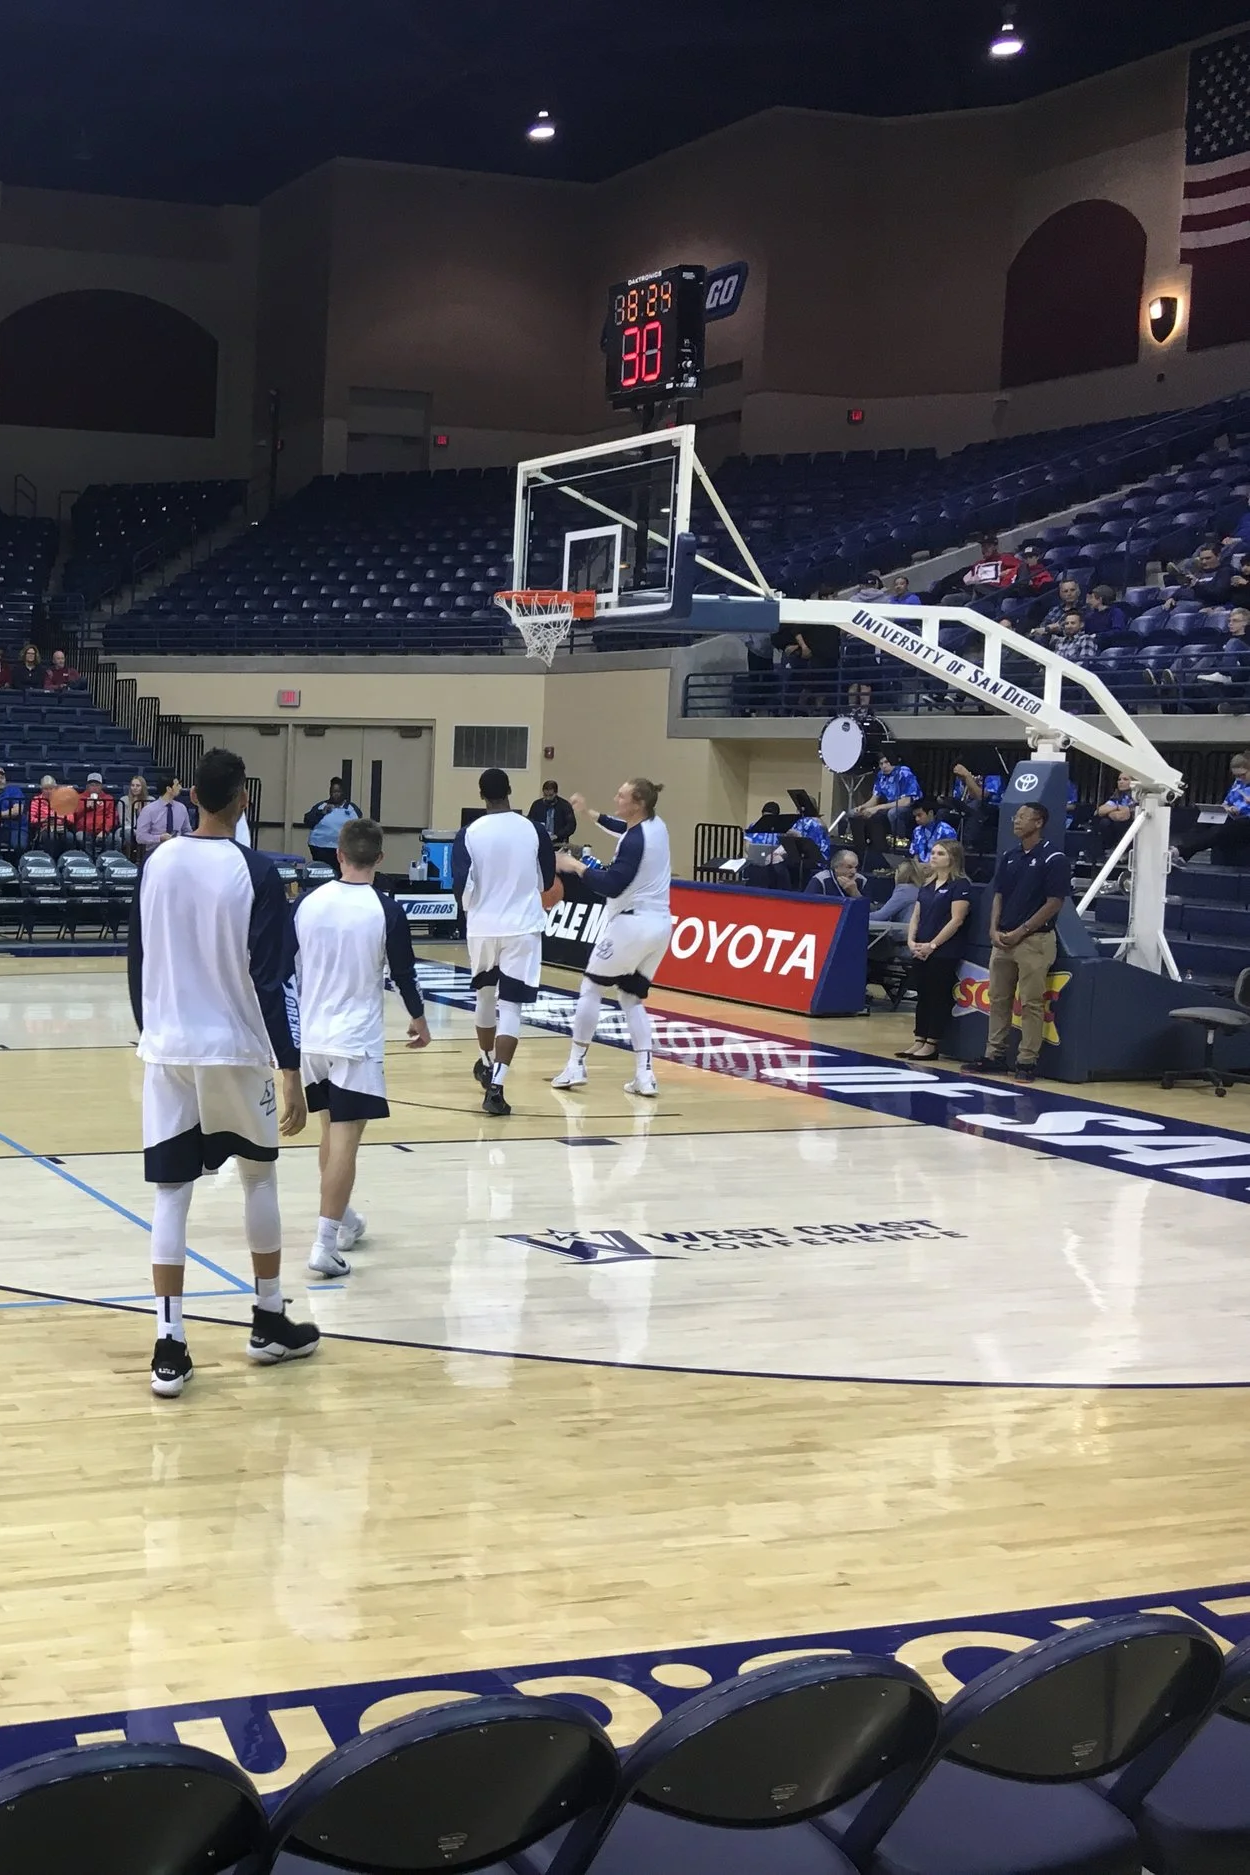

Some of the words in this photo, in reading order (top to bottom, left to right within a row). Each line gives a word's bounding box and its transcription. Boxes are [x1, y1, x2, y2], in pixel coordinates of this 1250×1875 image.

[705, 274, 739, 309] GO
[621, 321, 662, 387] 30
[852, 609, 945, 664] UNIVERSITY
[947, 659, 966, 675] OF
[967, 668, 1003, 695] SAN
[1002, 686, 1042, 716] DIEGO
[400, 900, 455, 914] TOREROS
[545, 900, 588, 940] CLE
[956, 1110, 1250, 1190] SA
[639, 1227, 786, 1244] WEST
[792, 1219, 943, 1237] COAST
[682, 1230, 969, 1252] CONFERENCE
